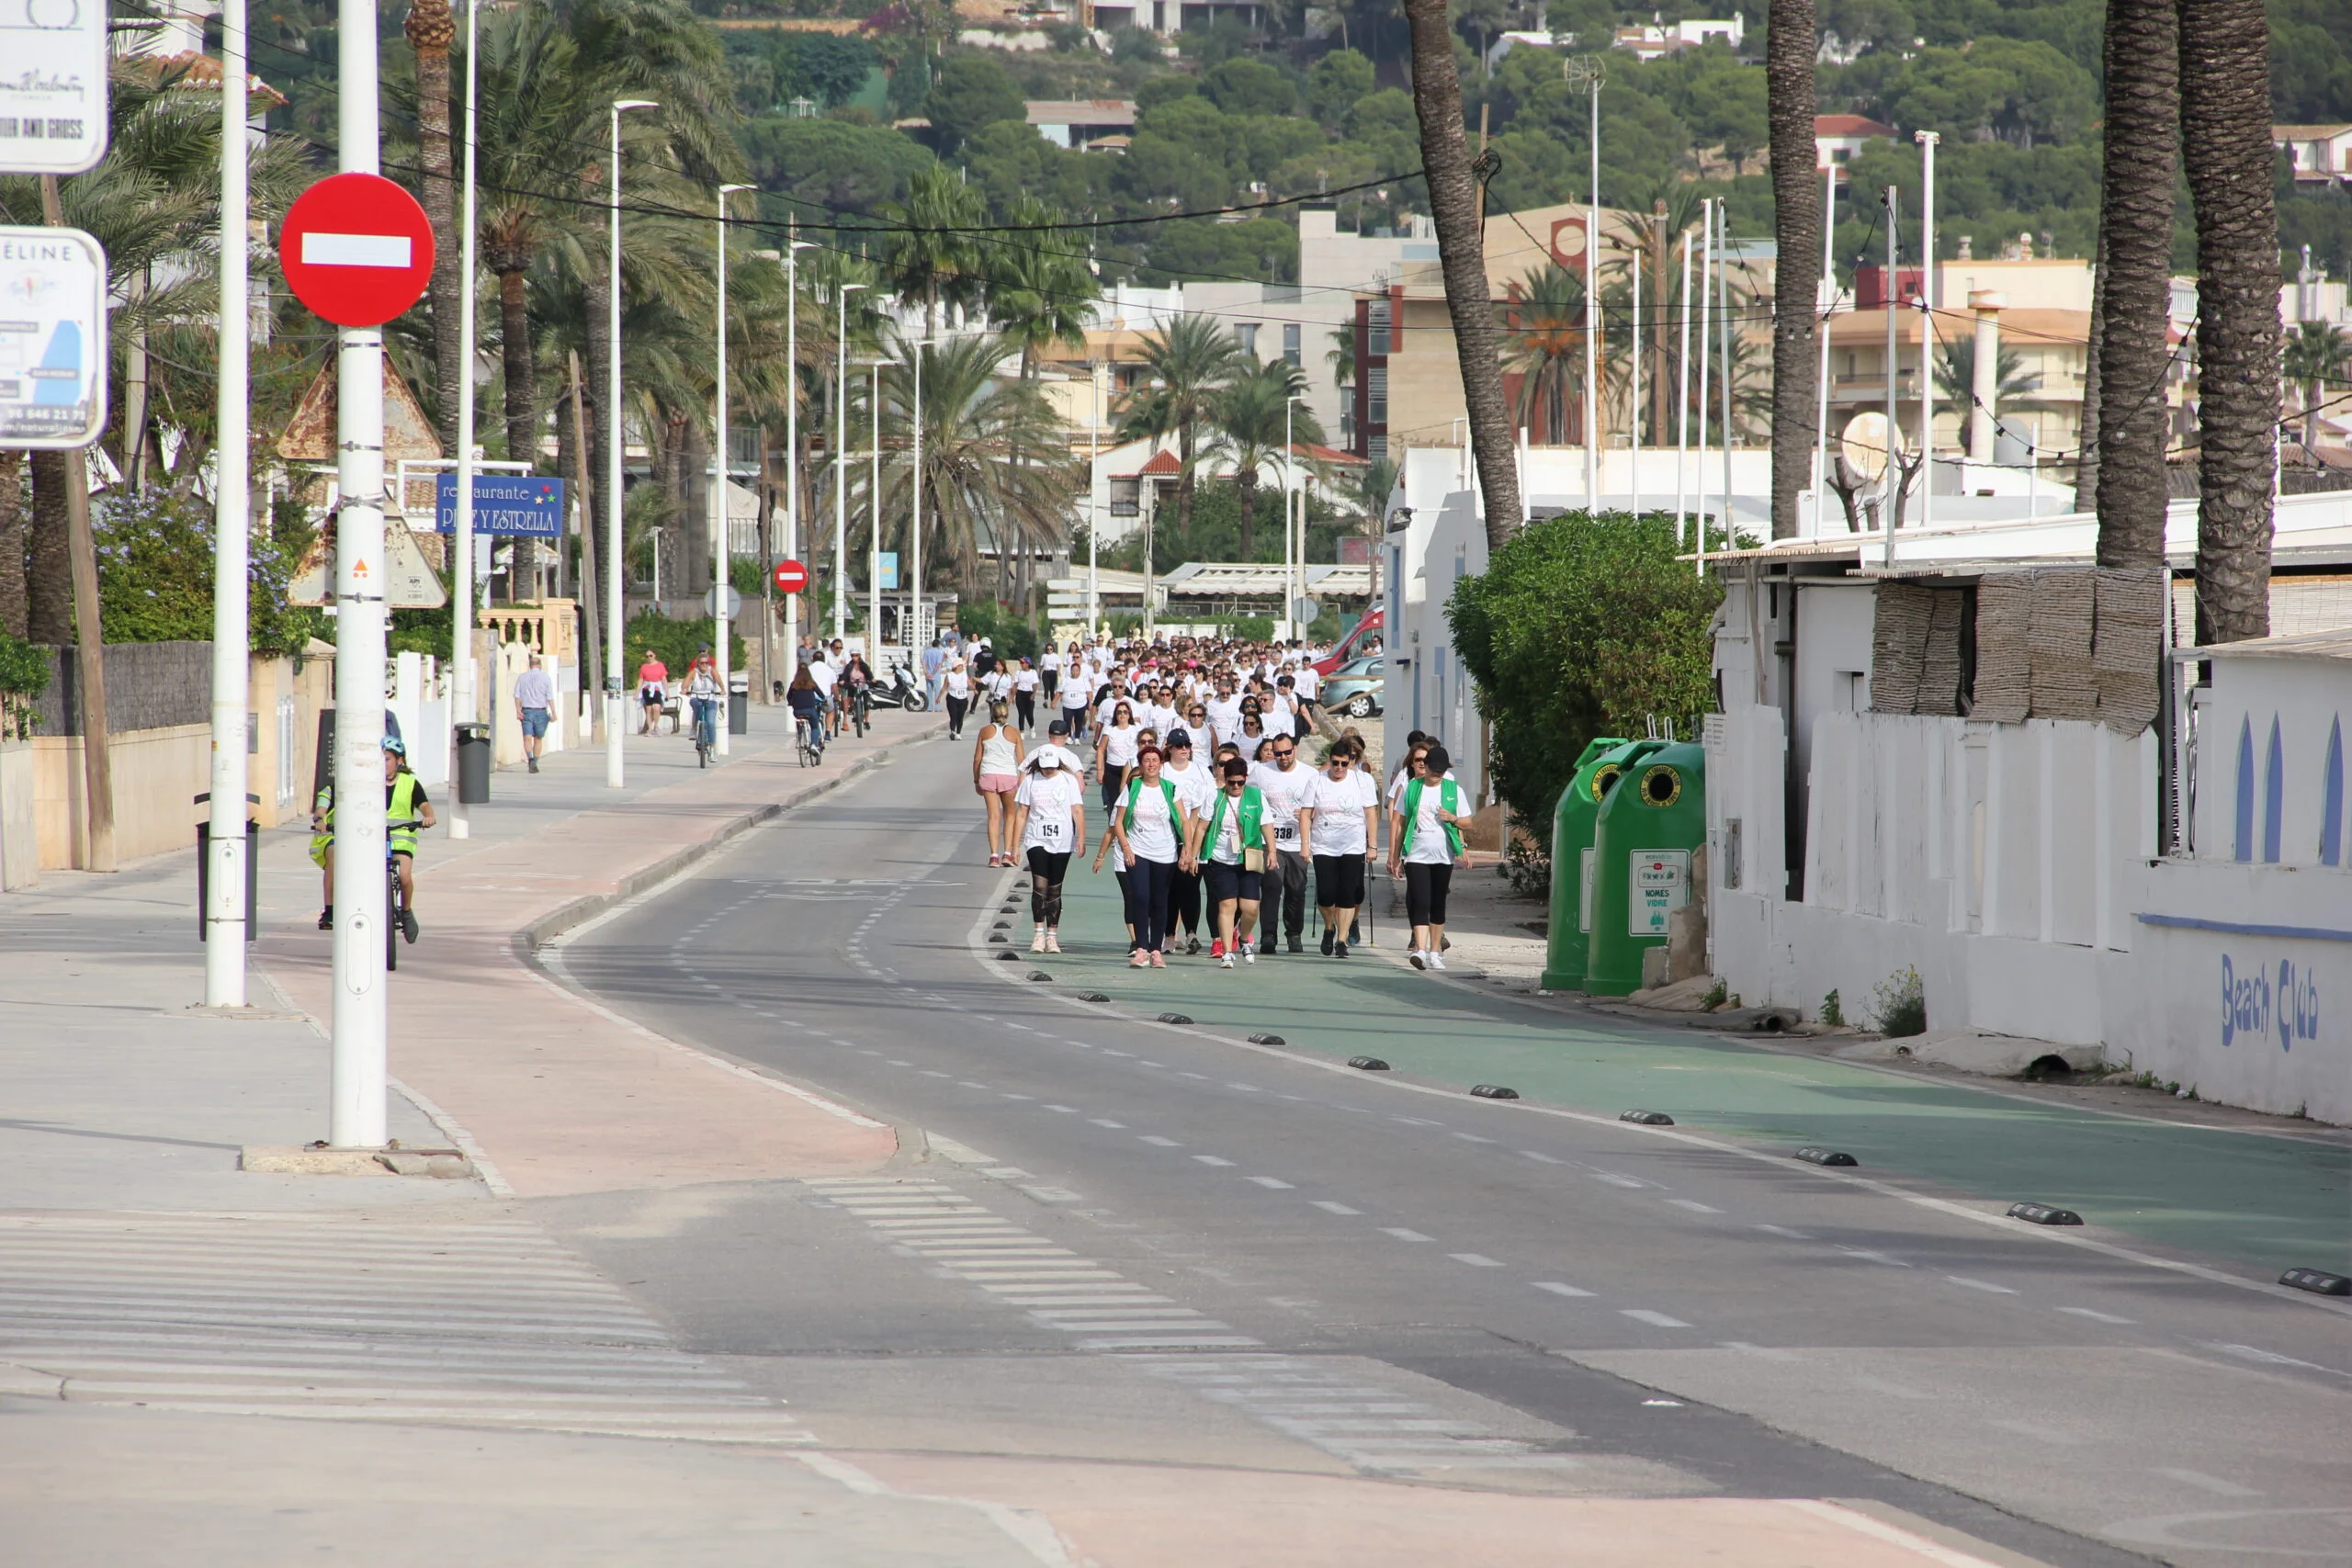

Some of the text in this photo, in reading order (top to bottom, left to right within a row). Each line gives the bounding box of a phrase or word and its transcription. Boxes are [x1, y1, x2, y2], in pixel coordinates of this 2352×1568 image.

[23, 118, 44, 138] AND
[47, 118, 84, 139] GROSS
[443, 485, 530, 501] reaurante
[481, 509, 491, 529] Y
[492, 509, 555, 532] ESTRELLA
[1042, 825, 1058, 836] 154
[1273, 828, 1292, 839] 338
[2222, 953, 2318, 1053] Beach Club
